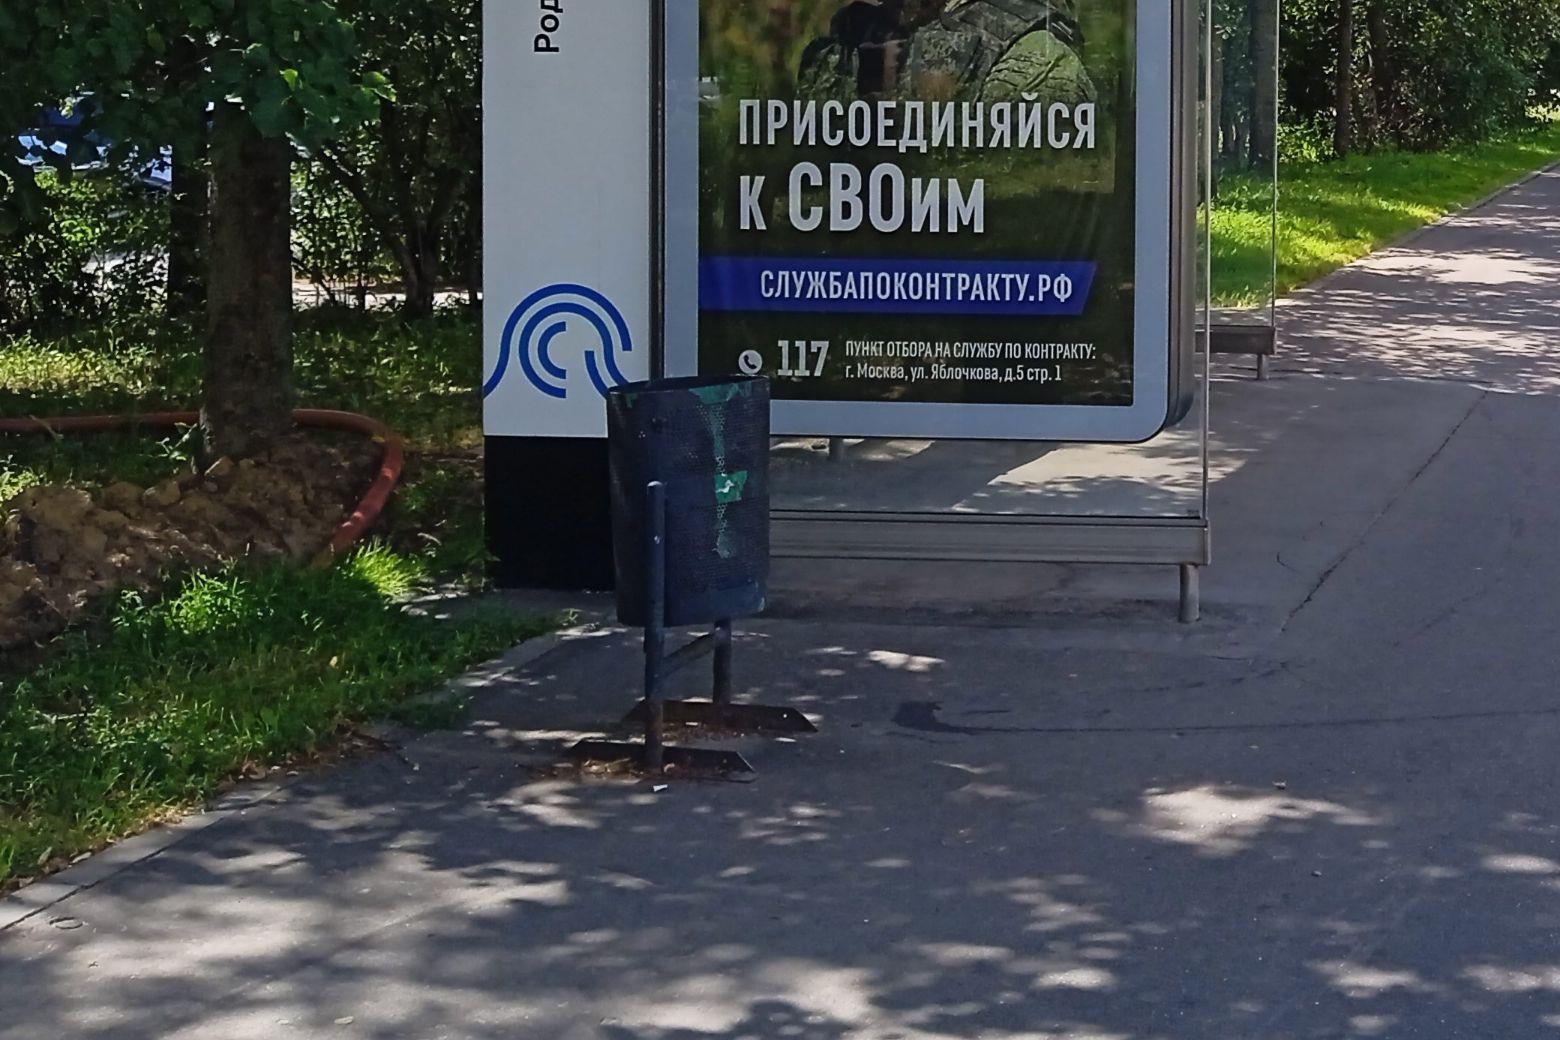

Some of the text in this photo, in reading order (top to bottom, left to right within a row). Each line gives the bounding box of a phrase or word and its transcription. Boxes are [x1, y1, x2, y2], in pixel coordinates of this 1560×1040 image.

[738, 92, 1097, 153] ПРИСОЕДИНЯЙСЯ
[760, 270, 1073, 303] СЛУЖБАПОКОНТРАКТУ.РФ
[777, 340, 830, 377] 117
[845, 340, 1097, 360] ПУНКТ ОТБОРА НА СЛУЖБУ ПО КОНТРАКТУ:
[845, 363, 1063, 384] г. Москва, ул. Яблочкова, д.5 стр. 1
